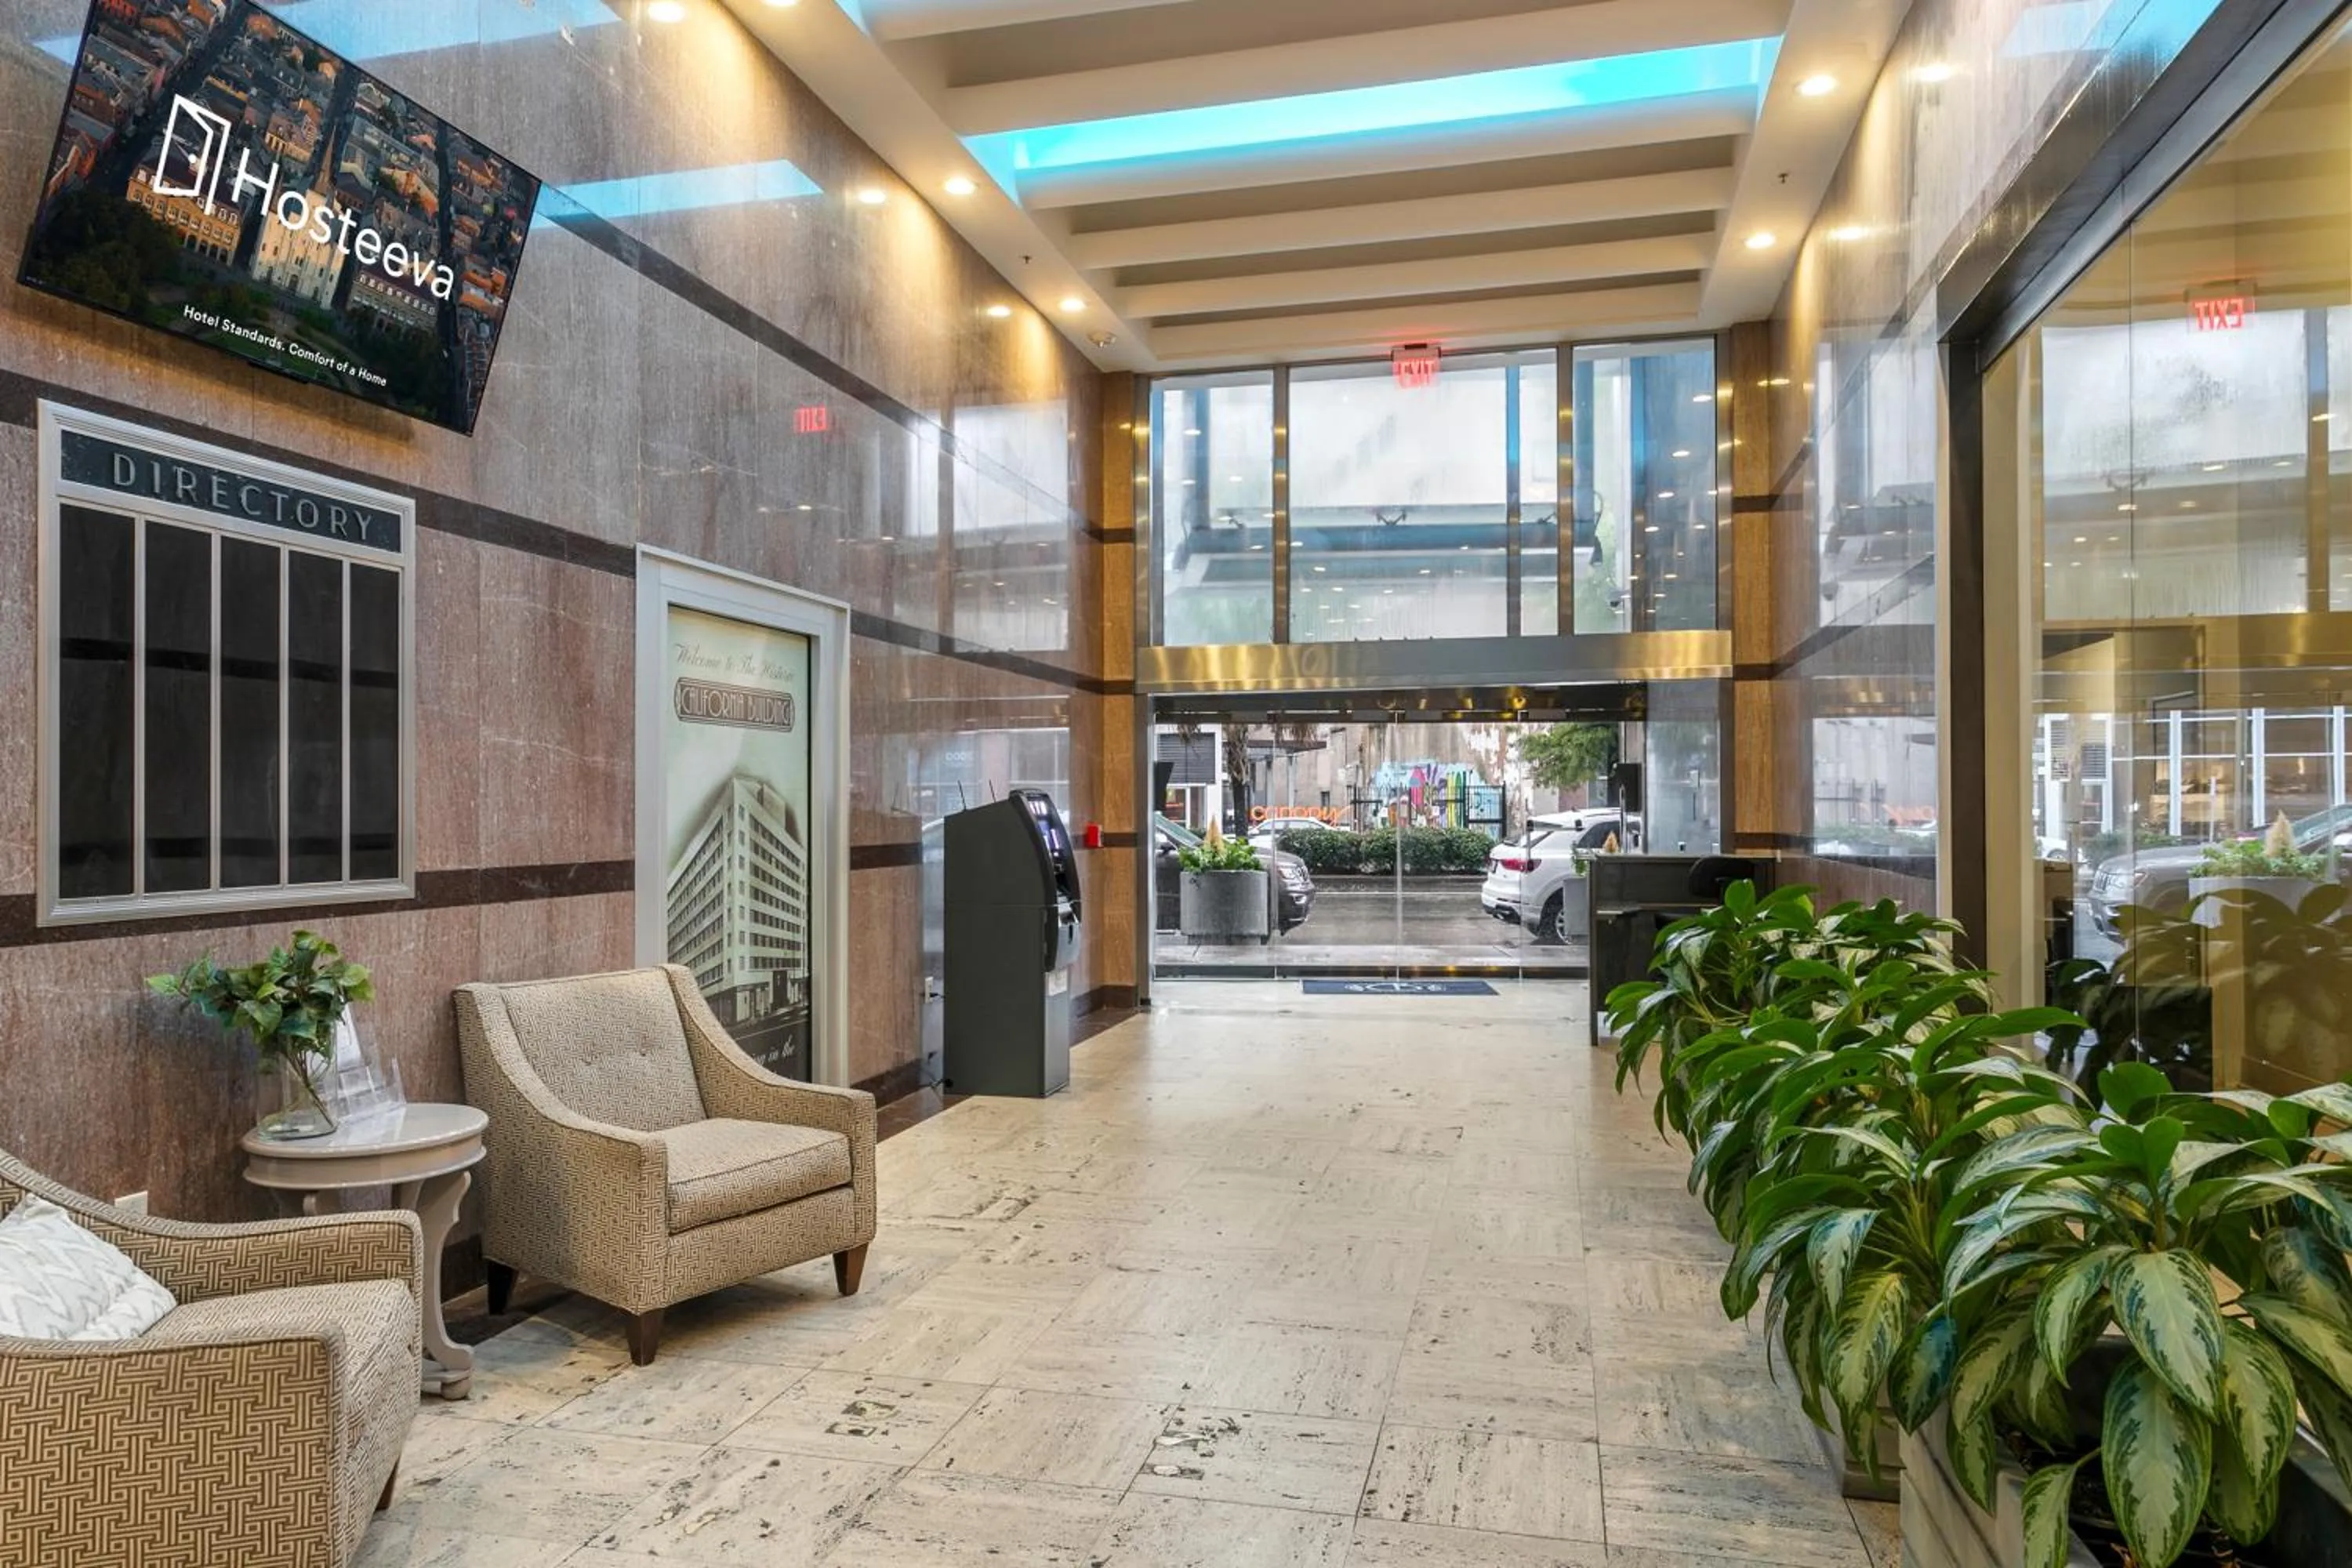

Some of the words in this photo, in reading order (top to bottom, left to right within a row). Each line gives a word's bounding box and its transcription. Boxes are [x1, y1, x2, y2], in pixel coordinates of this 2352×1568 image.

[231, 147, 455, 300] Hosteeva
[183, 305, 219, 327] Hotel
[222, 318, 285, 350] Standards.
[289, 343, 335, 368] Comfort
[336, 361, 349, 372] of
[358, 367, 387, 387] Home
[1399, 358, 1435, 386] EXIT
[113, 452, 372, 540] DIRECTORY
[674, 641, 721, 668] Welcome
[739, 652, 756, 675] The
[681, 687, 745, 719] CALIFORNIA
[747, 695, 790, 725] BUILDING
